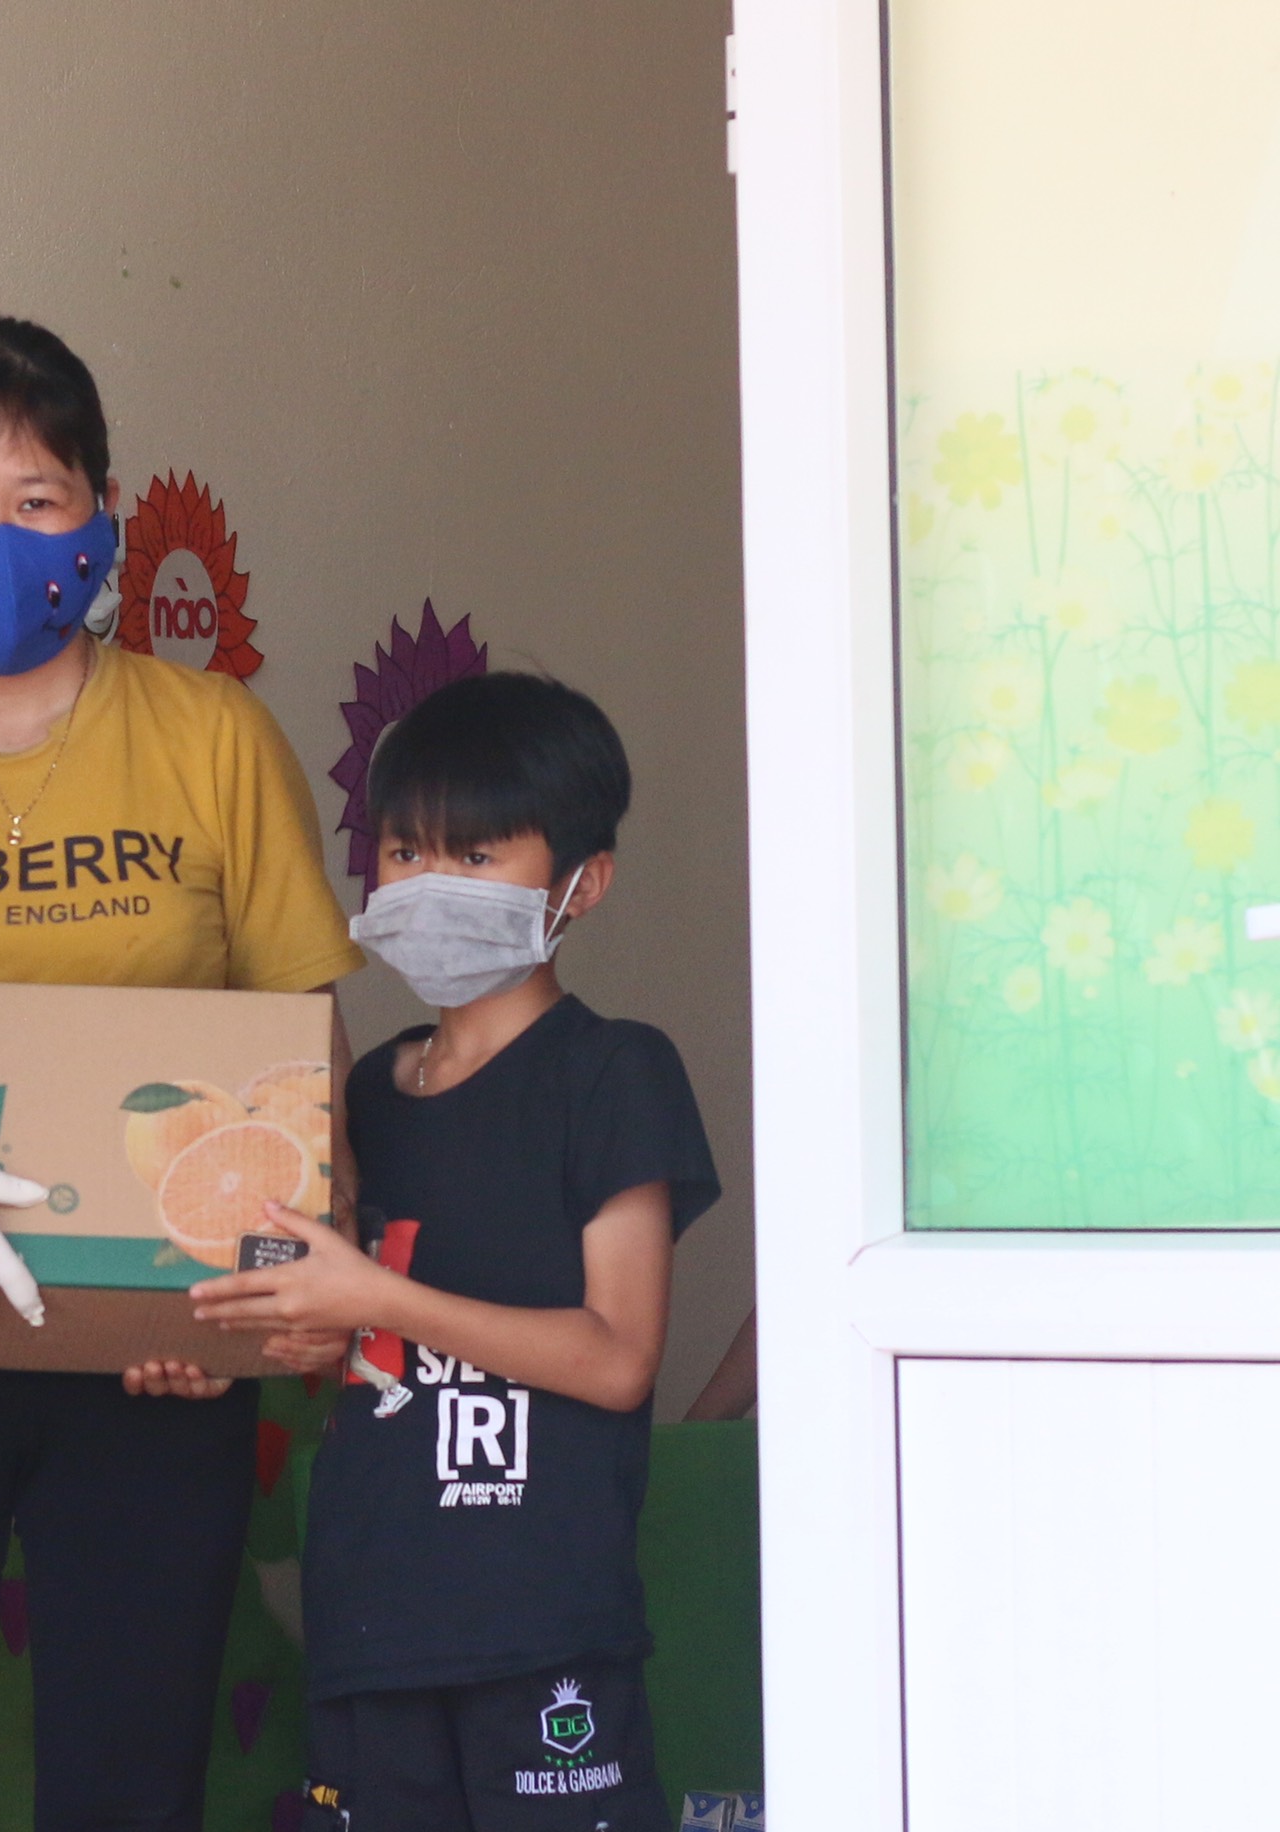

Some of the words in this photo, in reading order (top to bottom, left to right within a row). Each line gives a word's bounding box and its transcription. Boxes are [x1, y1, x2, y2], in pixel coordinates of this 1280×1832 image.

[154, 577, 217, 639] nào
[6, 895, 151, 926] ENGLAND
[550, 1714, 588, 1737] DG
[515, 1770, 556, 1794] DOLCE
[557, 1769, 568, 1794] &
[569, 1761, 623, 1793] GABBANA
